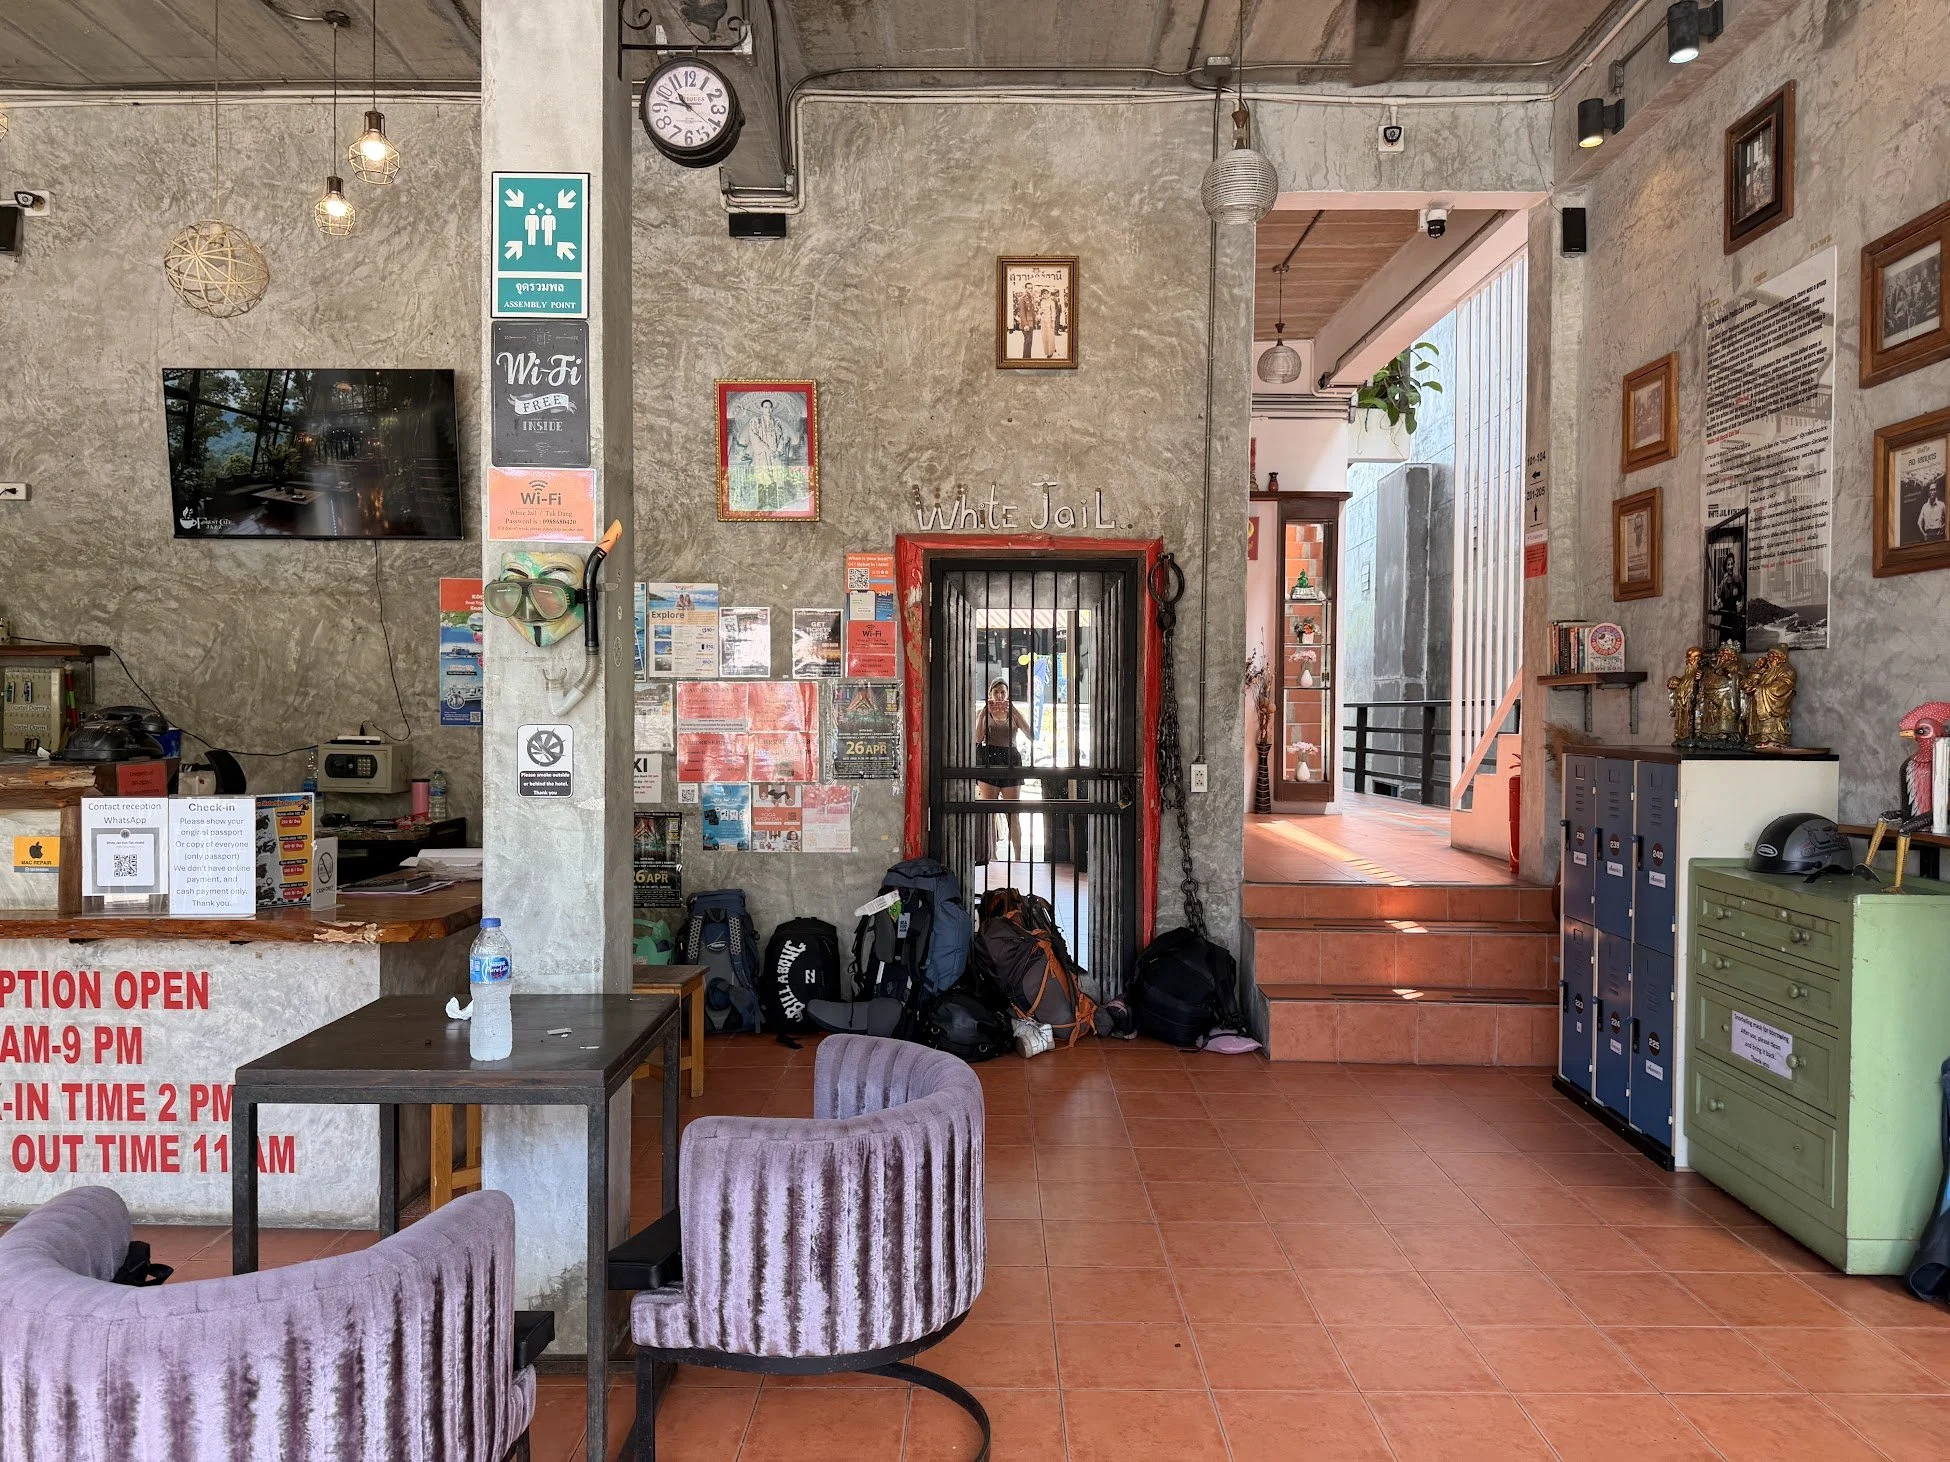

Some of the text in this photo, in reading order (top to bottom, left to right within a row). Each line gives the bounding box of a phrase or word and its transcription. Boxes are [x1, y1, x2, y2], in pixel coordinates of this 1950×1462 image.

[684, 70, 697, 88] 12
[684, 130, 693, 146] 6
[516, 282, 565, 295] จุดรวมพล
[551, 301, 576, 309] POINT
[496, 351, 583, 387] Wi-Fi
[523, 394, 562, 413] FREE
[523, 421, 563, 432] INSIDE
[521, 492, 562, 505] Wi-Fi
[651, 611, 685, 620] Explore
[846, 741, 887, 754] 26 APR
[88, 803, 162, 812] Contact reception
[188, 803, 235, 812] Check-in
[103, 816, 147, 825] WhatsApp
[180, 829, 243, 837] original passport
[184, 853, 240, 861] (only passport)
[187, 864, 206, 872] don't
[646, 873, 669, 883] APR
[196, 888, 229, 896] payment
[230, 888, 248, 896] only.
[192, 899, 232, 908] Thank you.
[776, 939, 807, 1022] BILLABONG
[114, 970, 209, 1010] OPEN
[0, 1025, 143, 1065] AM-9 PM
[0, 1083, 233, 1122] -IN TIME 2 PM
[12, 1135, 84, 1173] OUT
[95, 1135, 180, 1173] TIME
[193, 1135, 228, 1173] 11
